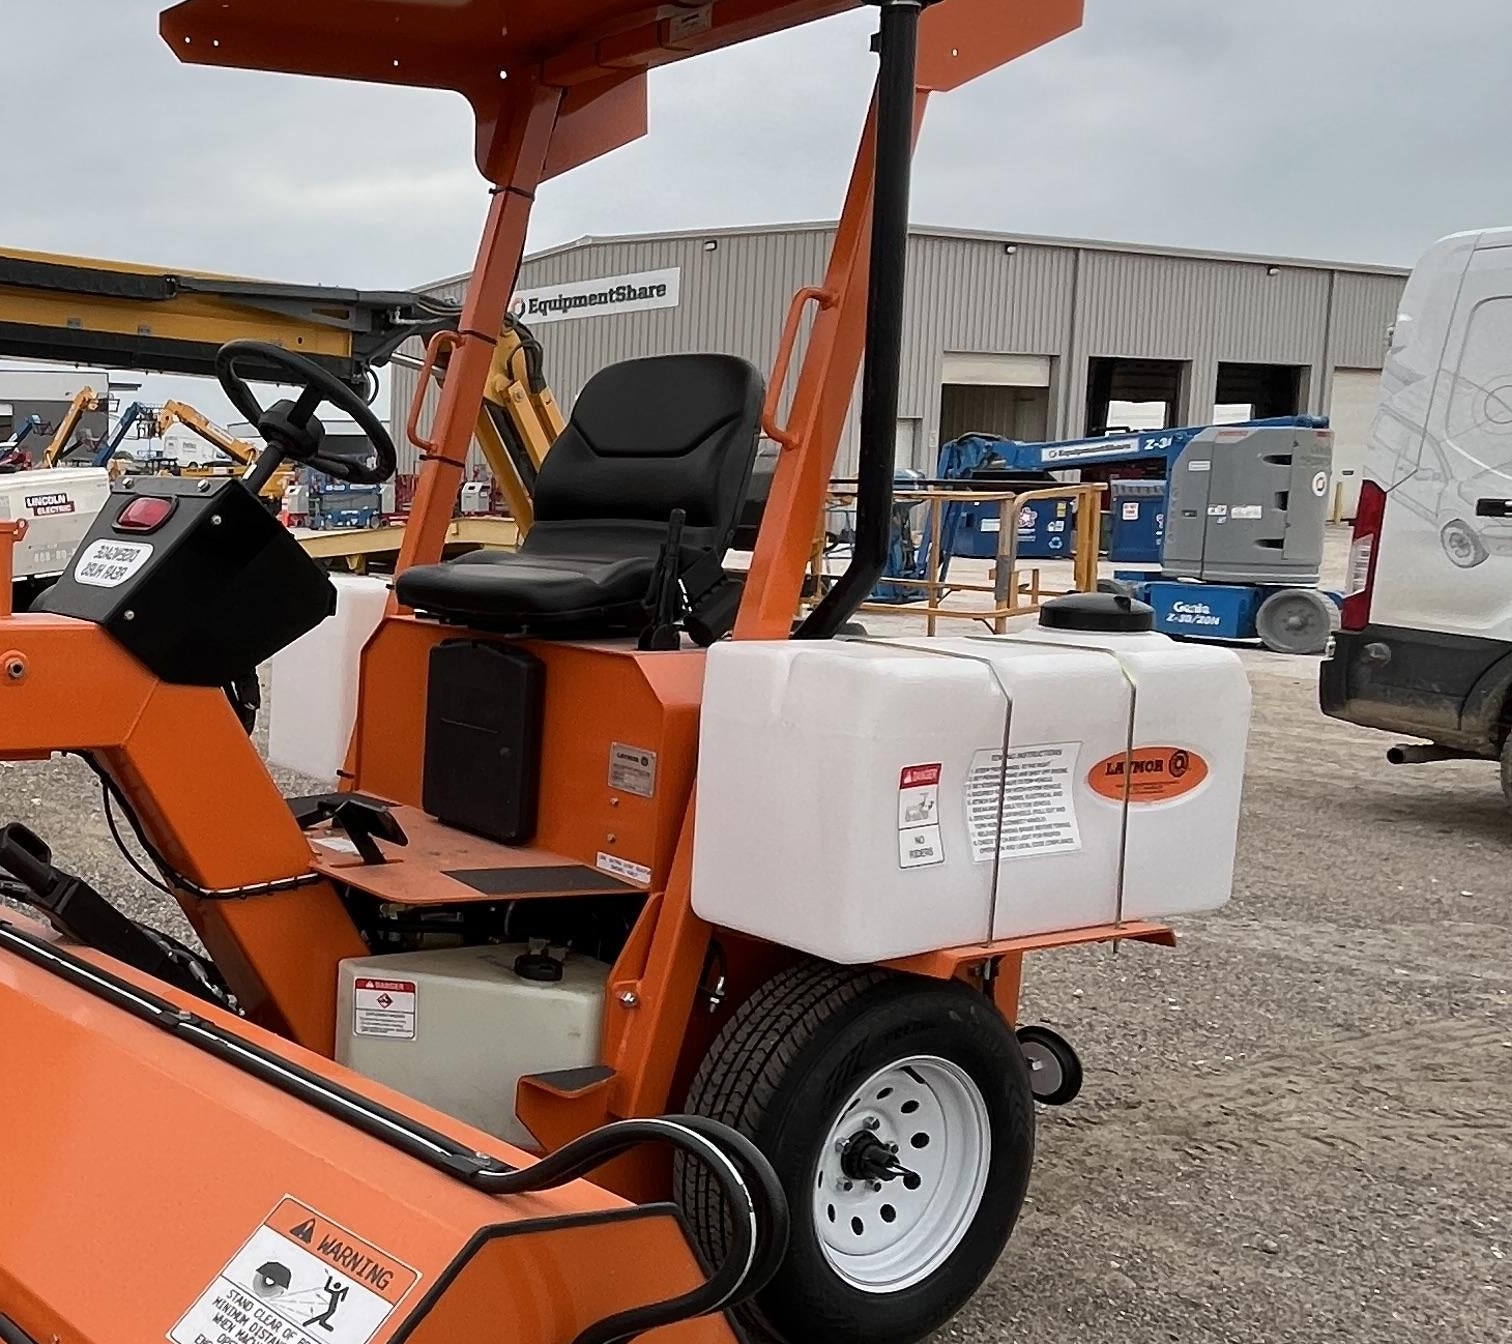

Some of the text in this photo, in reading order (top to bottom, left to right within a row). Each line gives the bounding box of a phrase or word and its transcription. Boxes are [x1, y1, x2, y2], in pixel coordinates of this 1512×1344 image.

[528, 283, 667, 316] EquipmentShare
[26, 493, 67, 508] LINCOLN
[317, 1234, 394, 1291] WARNING
[212, 1296, 248, 1330] MINIMUM
[212, 1313, 236, 1334] WHEN
[226, 1288, 252, 1312] STAND
[253, 1307, 283, 1333] CLEAR
[284, 1327, 297, 1342] OF
